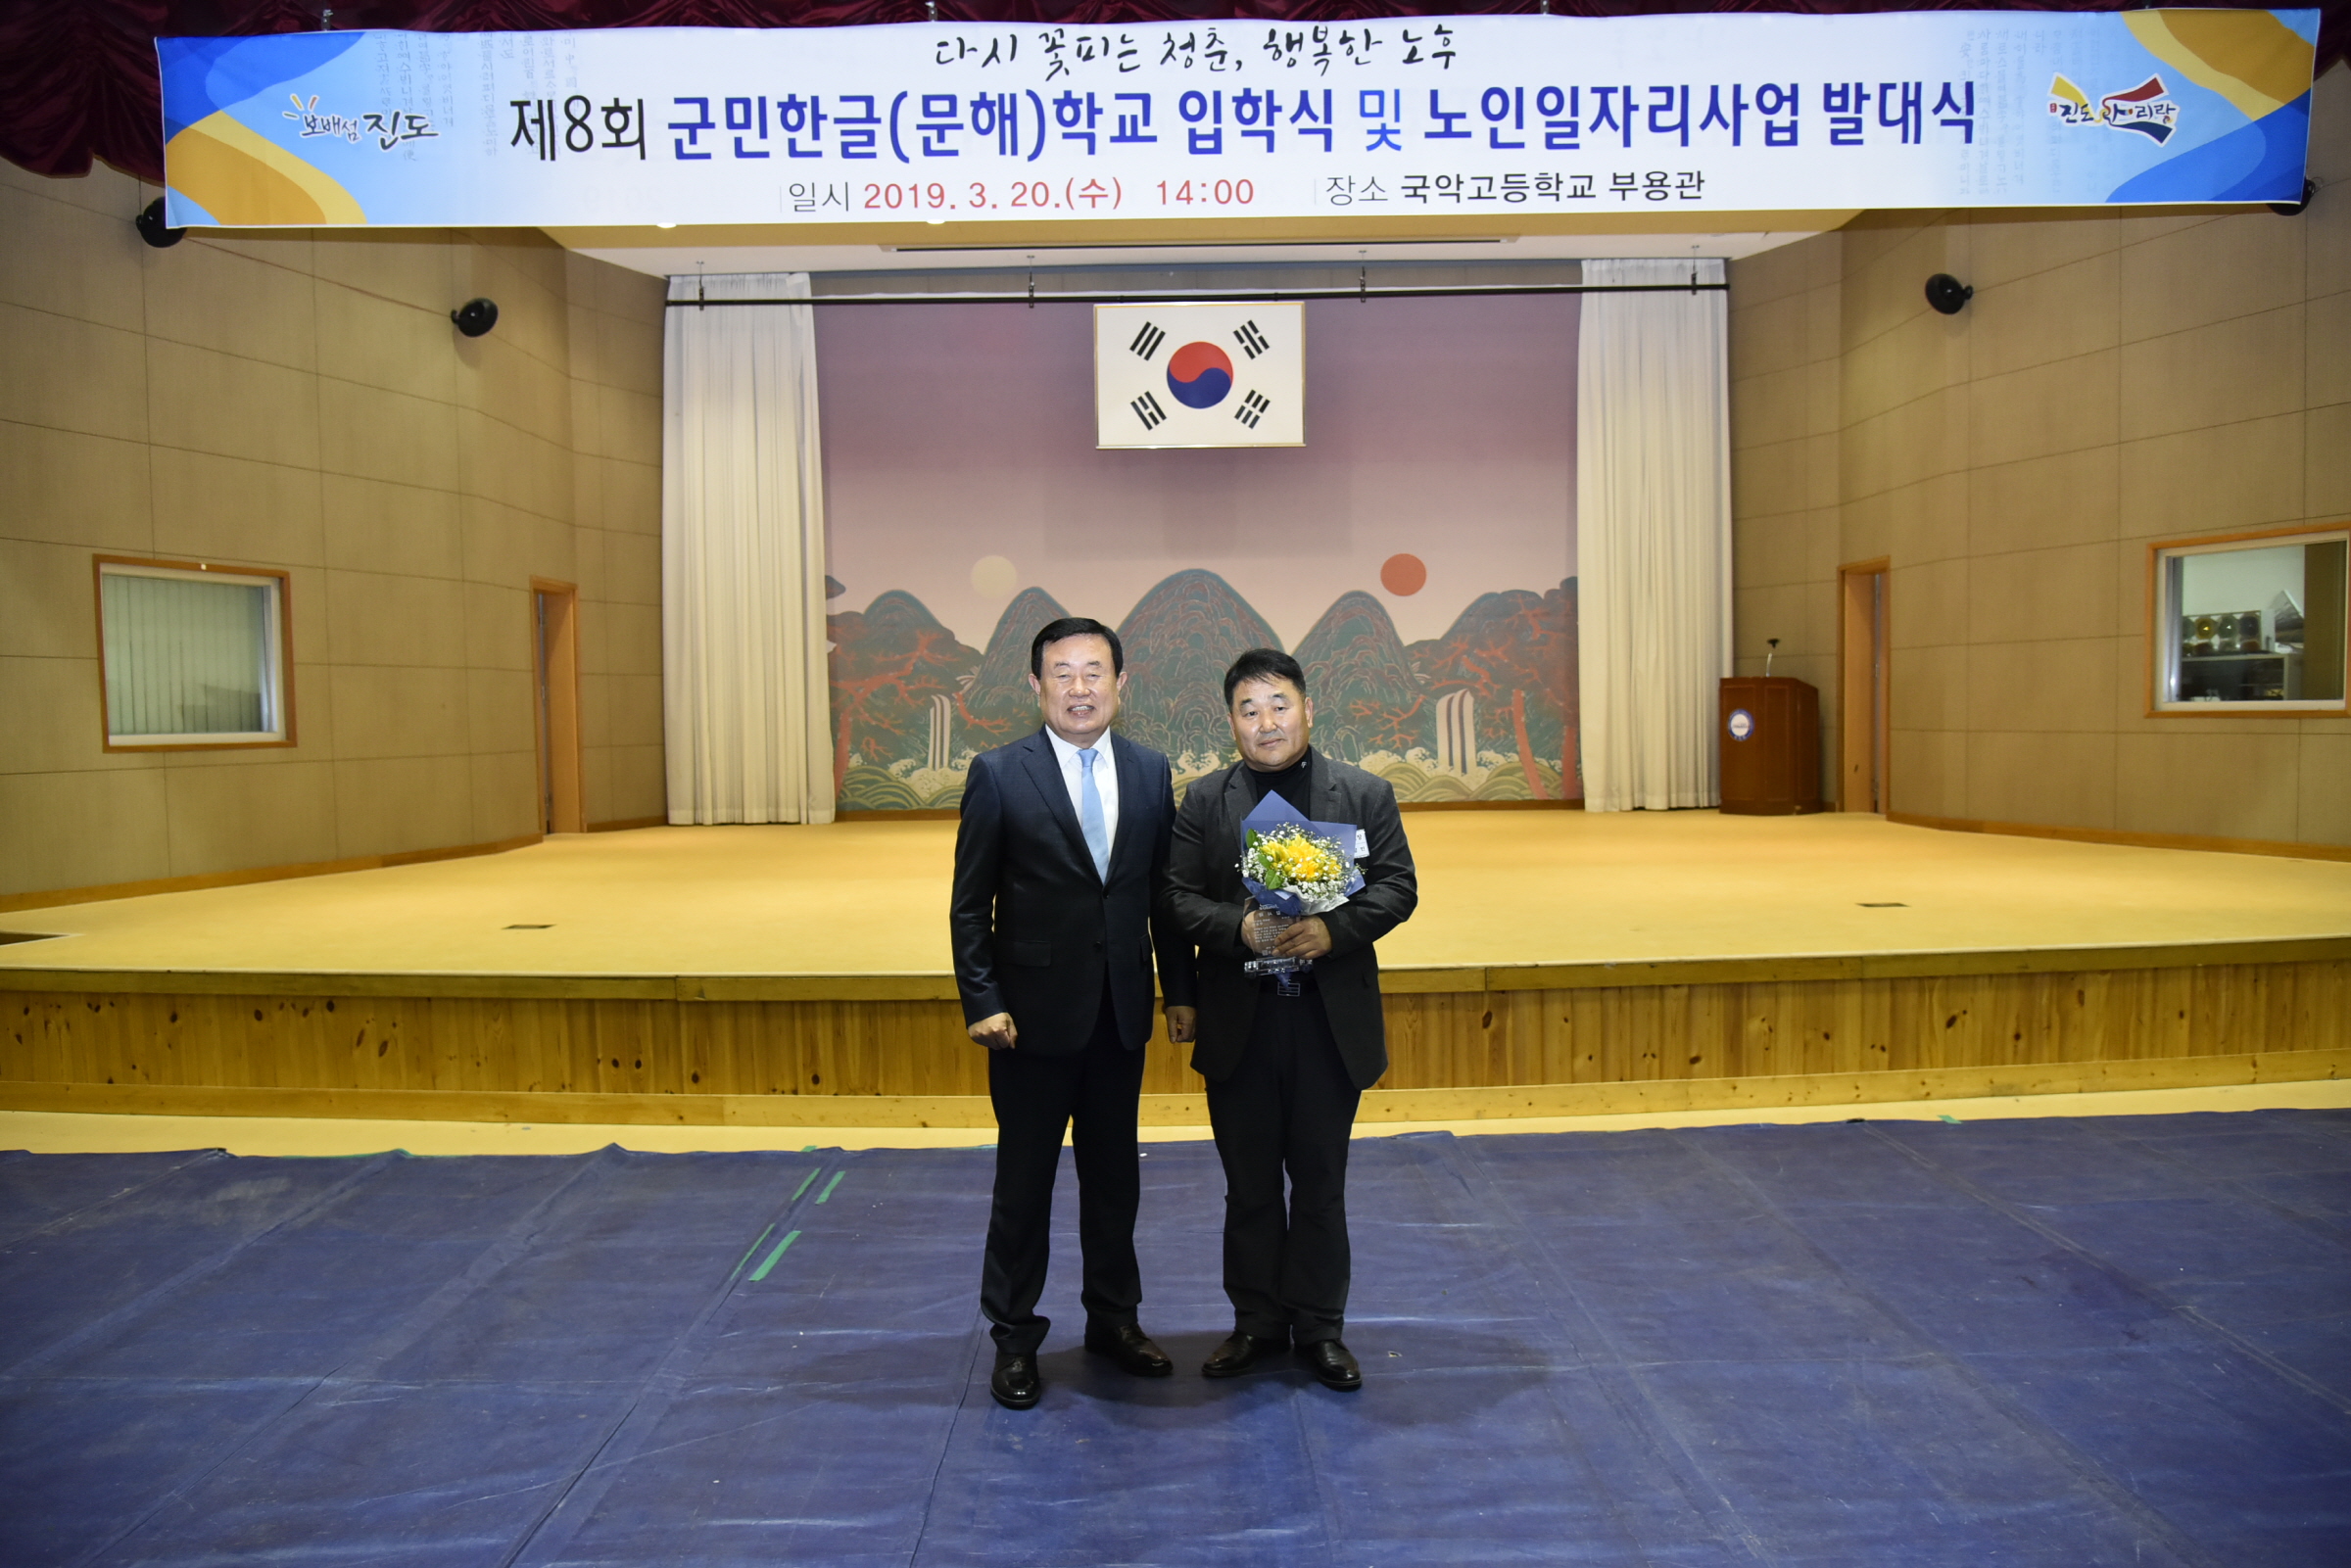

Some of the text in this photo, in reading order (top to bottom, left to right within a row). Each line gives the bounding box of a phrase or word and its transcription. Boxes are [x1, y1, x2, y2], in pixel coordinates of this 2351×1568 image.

[936, 24, 1456, 81] 다시 꽃피는 청춘, 행복한 노후
[302, 111, 439, 151] 보배섬 진도
[509, 95, 646, 162] 제8회
[668, 89, 1157, 164] 군민한글(문해)학교
[1178, 87, 1332, 155] 입학식
[1360, 88, 1402, 152] 및
[1424, 83, 1799, 150] 노인일자리사업
[1823, 80, 1975, 146] 발대식
[790, 181, 849, 213] 일시
[864, 182, 956, 210] 2019.
[969, 182, 997, 209] 3.
[1157, 178, 1254, 206] 14:00
[1326, 174, 1388, 206] 장소
[1401, 172, 1597, 204] 국악고등학교
[1609, 169, 1705, 202] 부용관
